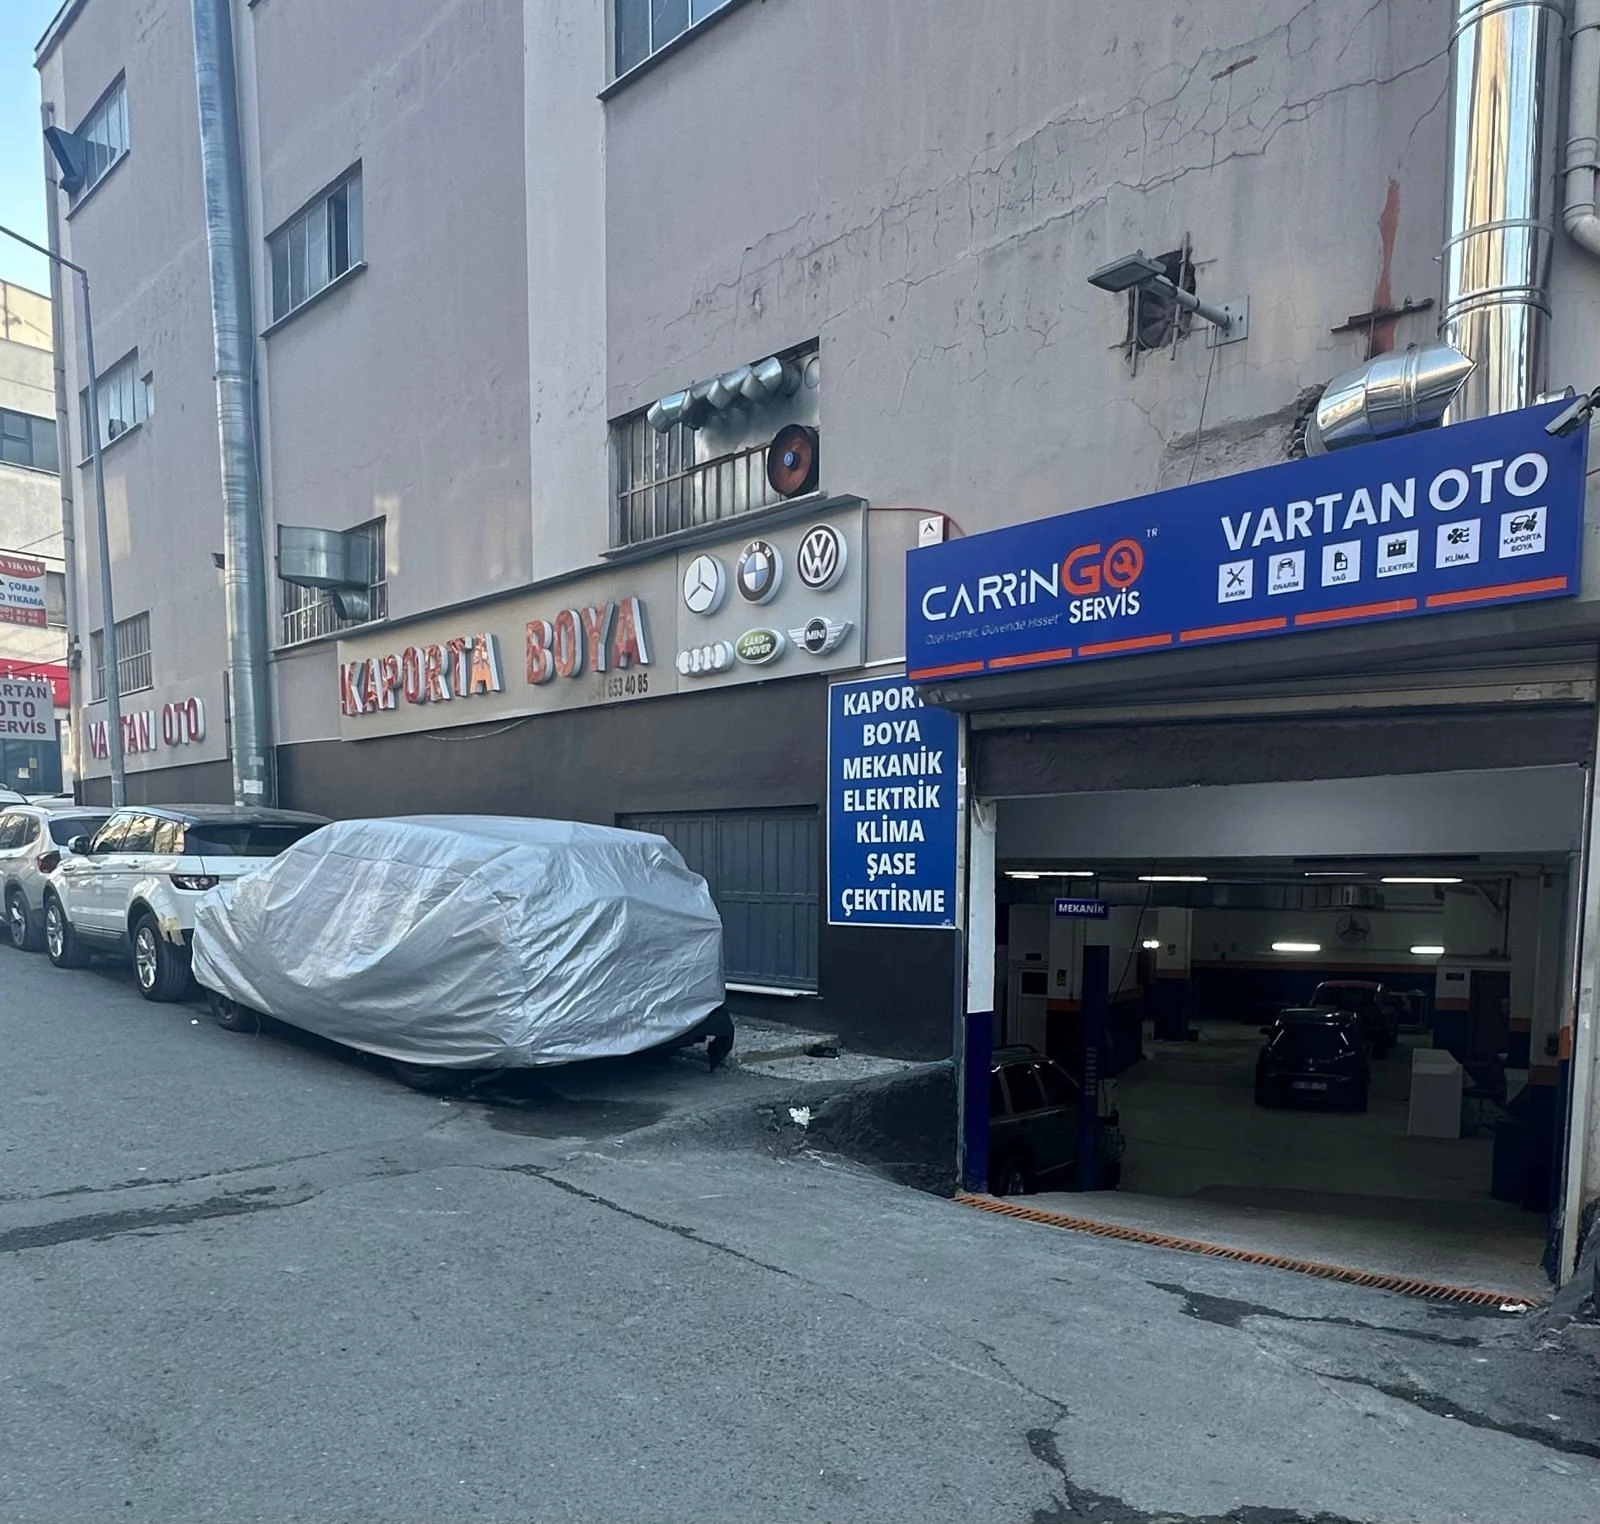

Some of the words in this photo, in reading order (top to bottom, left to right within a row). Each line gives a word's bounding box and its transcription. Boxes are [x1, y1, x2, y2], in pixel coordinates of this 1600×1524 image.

[1220, 478, 1416, 552] VARTAN
[1428, 452, 1549, 511] OTO
[1503, 533, 1543, 546] KAPORTA
[1444, 552, 1470, 563] KLİMA
[8, 581, 40, 594] ÇORAP
[8, 594, 45, 607] YIKAMA
[1069, 587, 1140, 625] SERVİS
[744, 634, 765, 647] LAND
[806, 629, 826, 641] MINI
[339, 631, 501, 717] KAPORTA
[526, 597, 649, 685] BOYA
[746, 643, 772, 656] ROVER
[0, 684, 47, 699] RTAN
[625, 674, 636, 695] 40
[637, 672, 648, 693] 85
[843, 686, 925, 716] KAPOR
[88, 710, 156, 760] VATAN
[162, 697, 205, 746] OTO
[863, 720, 921, 747] BOYA
[843, 746, 944, 780] MEKANİK
[843, 779, 941, 812] ELEKTRİK
[856, 815, 925, 843] KLİMA
[866, 852, 916, 881] ŞASE
[841, 883, 945, 917] ÇEKTİRME
[1058, 902, 1105, 914] MEKANİK
